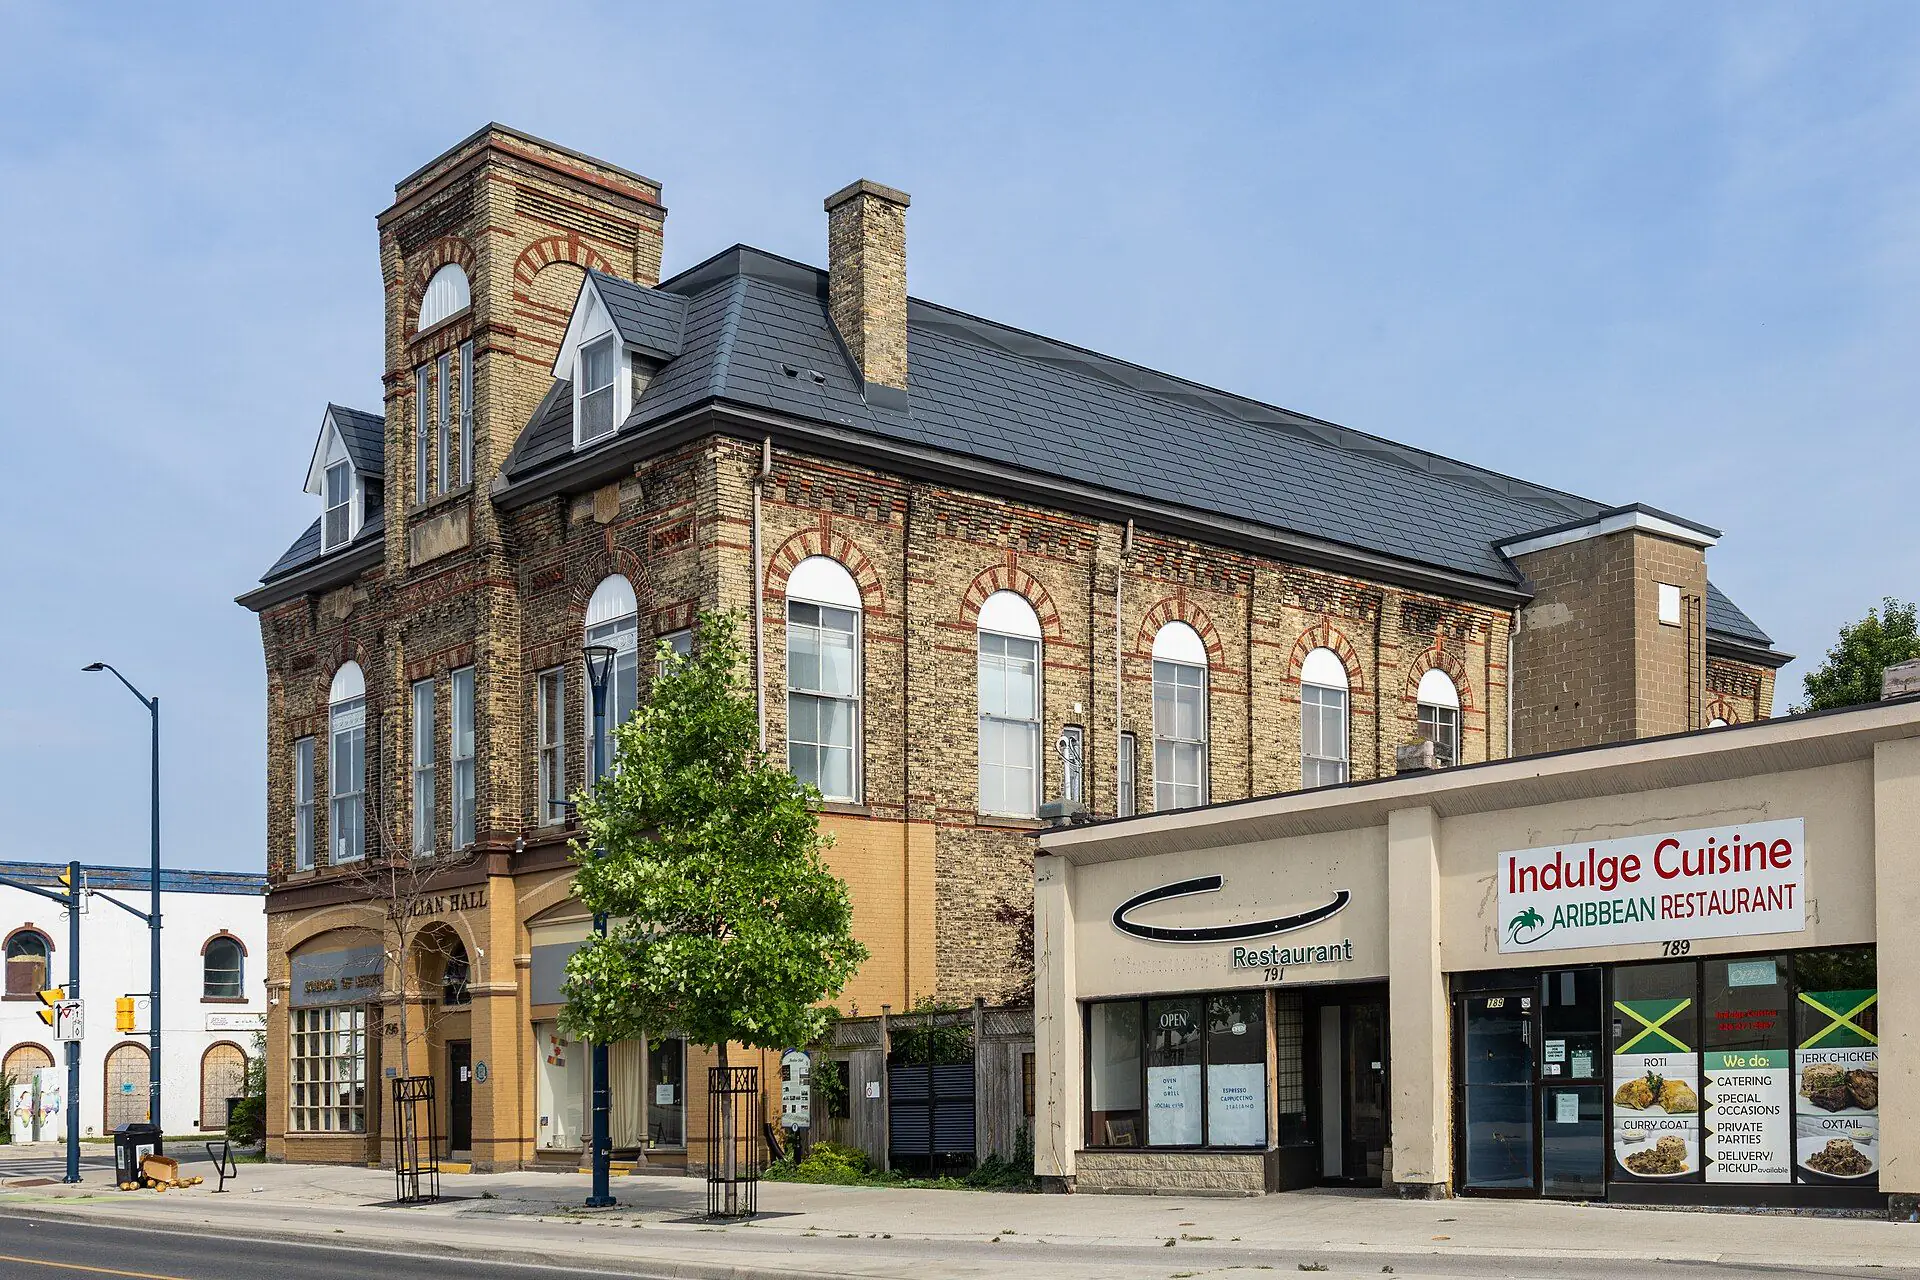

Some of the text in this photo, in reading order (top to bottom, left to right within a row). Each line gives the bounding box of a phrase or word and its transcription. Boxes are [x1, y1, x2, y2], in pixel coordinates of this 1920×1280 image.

[1508, 834, 1793, 895] Indulge Cuisine
[449, 890, 488, 912] HALL
[1661, 883, 1797, 920] RESTAURANT
[1232, 938, 1353, 968] Restaurant
[1661, 939, 1691, 957] 789
[1264, 967, 1285, 981] 791
[1488, 998, 1504, 1008] 789
[1160, 1013, 1188, 1027] OPEN
[1644, 1058, 1667, 1067] ROTI
[1723, 1054, 1770, 1067] We do:
[1801, 1052, 1878, 1063] JERK CHICKEN
[1717, 1076, 1772, 1086] CATERING
[1717, 1093, 1761, 1103] SPECIAL
[1717, 1105, 1780, 1115] OCCASIONS
[1623, 1120, 1689, 1130] CURRY GOAT
[1717, 1122, 1763, 1132] PRIVATE
[1822, 1119, 1862, 1129] OXTAIL
[1717, 1134, 1761, 1144] PARTIES
[1718, 1151, 1774, 1161] DELIVERY/
[1718, 1163, 1789, 1174] PICKUP available
